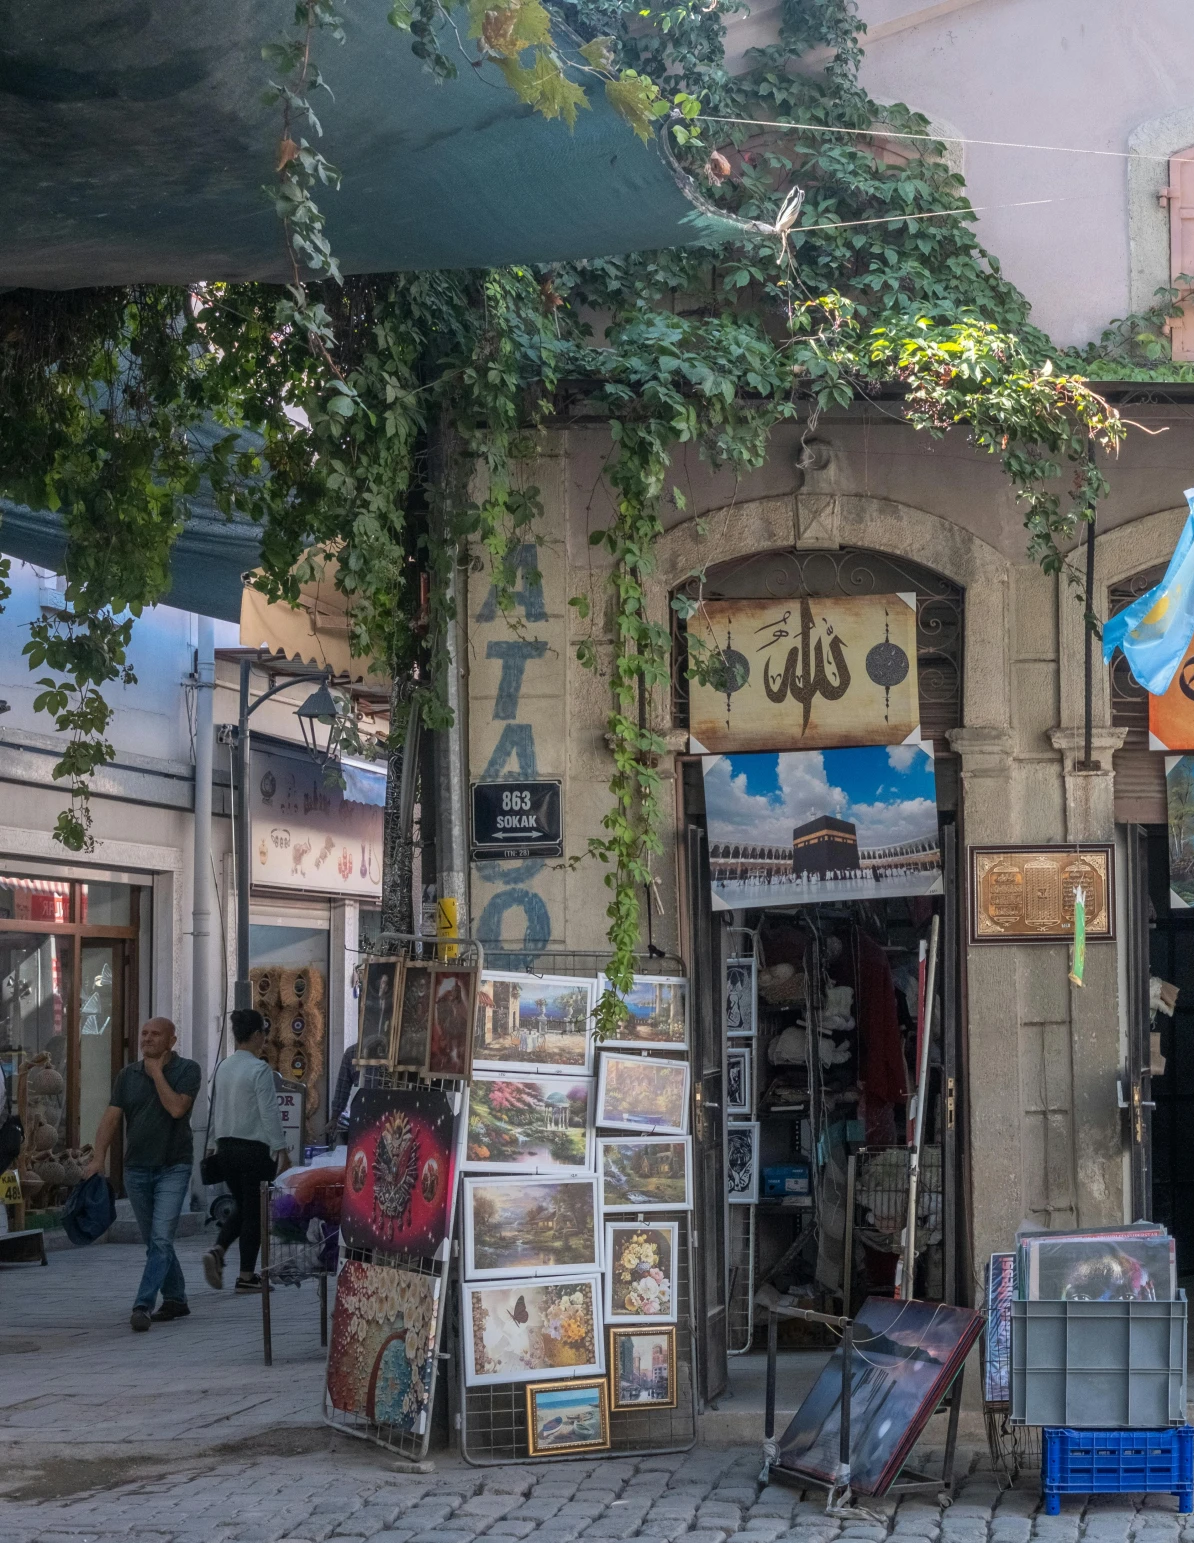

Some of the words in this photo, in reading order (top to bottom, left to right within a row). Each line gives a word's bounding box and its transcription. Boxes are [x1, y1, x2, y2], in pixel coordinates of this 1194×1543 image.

[502, 790, 531, 811] 863
[496, 815, 537, 828] SOKAK
[997, 1256, 1014, 1299] Messi
